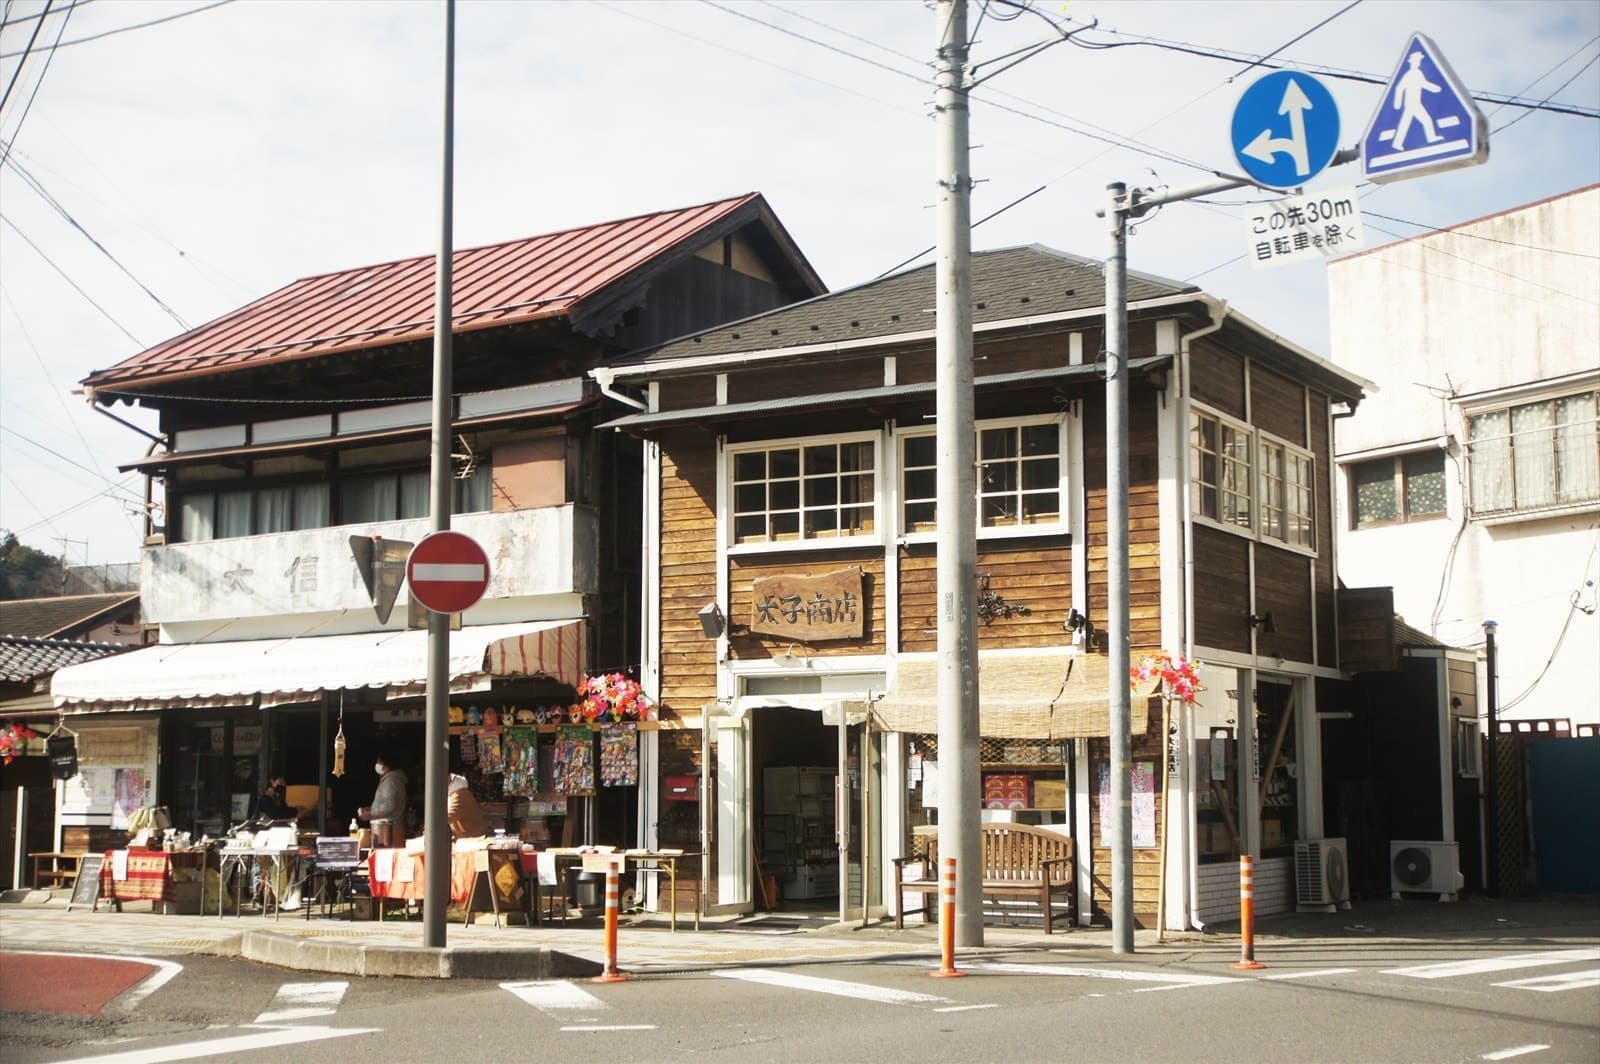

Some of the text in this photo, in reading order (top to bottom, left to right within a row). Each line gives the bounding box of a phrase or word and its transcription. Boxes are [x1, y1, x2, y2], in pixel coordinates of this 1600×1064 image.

[1252, 198, 1353, 234] この先30m
[1255, 223, 1357, 261] 自転車を除く
